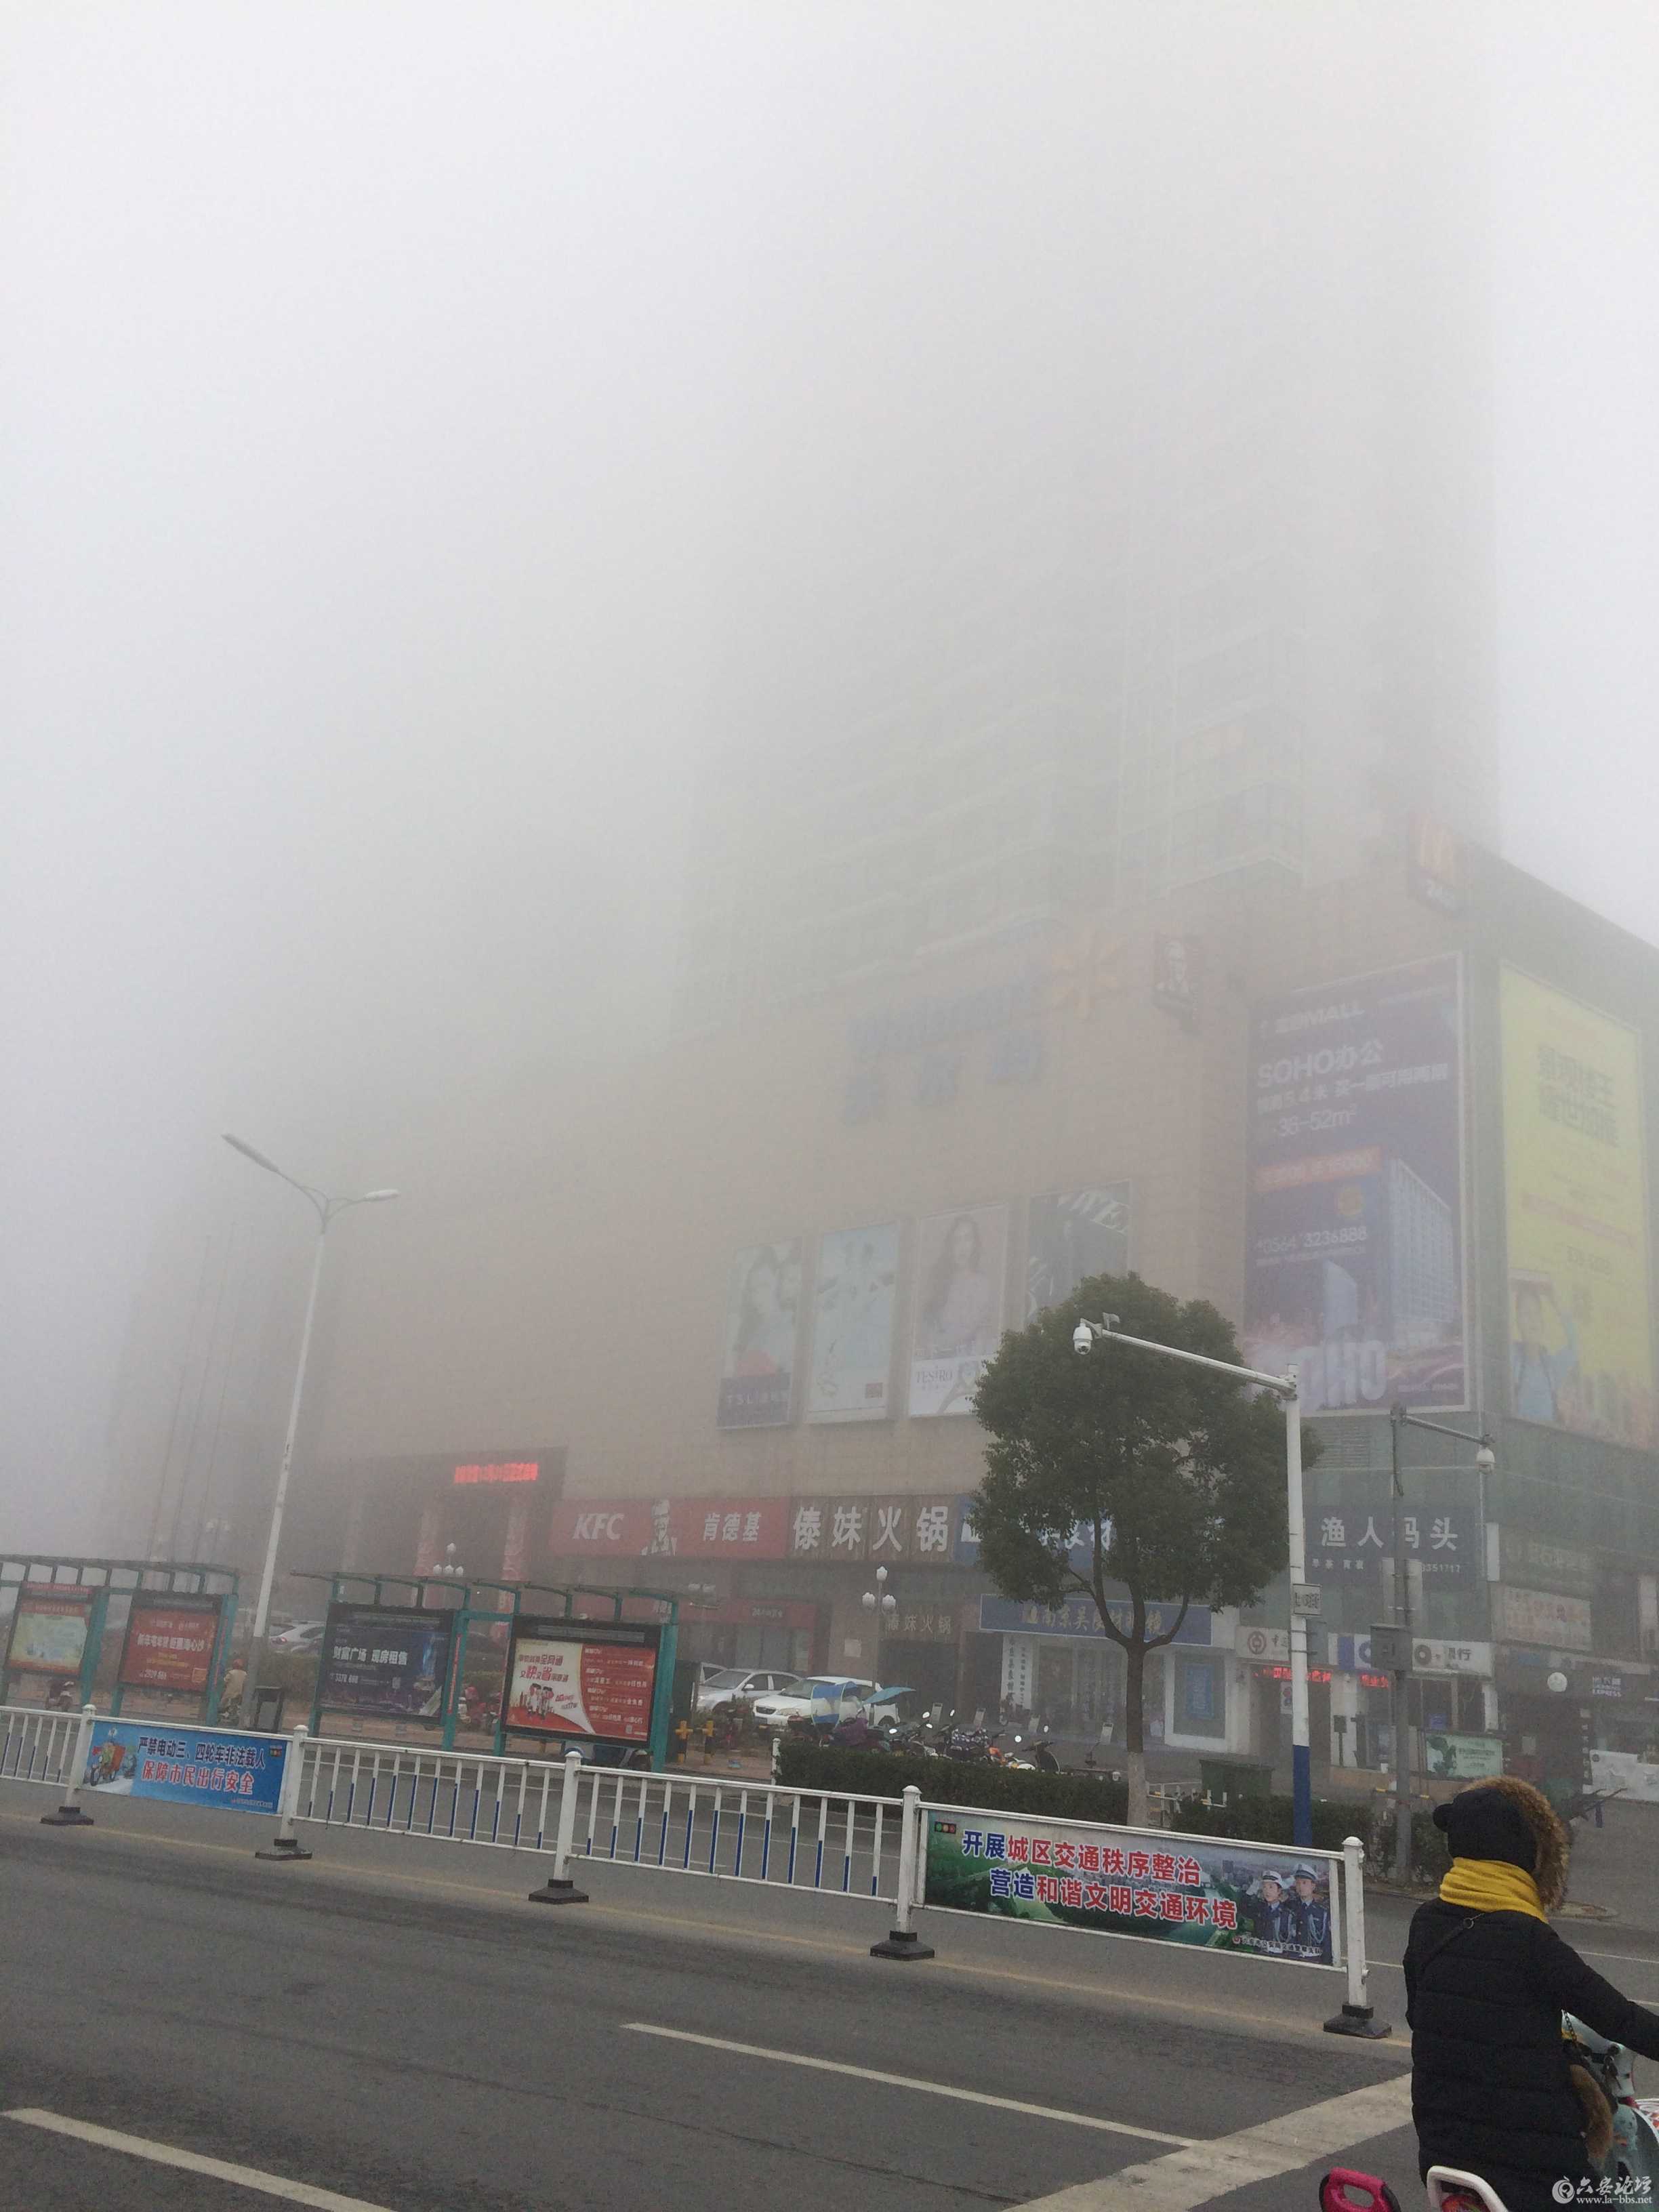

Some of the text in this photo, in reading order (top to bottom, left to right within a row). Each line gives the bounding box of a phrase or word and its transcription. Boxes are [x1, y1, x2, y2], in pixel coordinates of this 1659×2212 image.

[572, 1512, 625, 1540] KFC
[702, 1511, 760, 1543] 肯德基
[793, 1505, 949, 1553] 傣妹火锅
[333, 1646, 367, 1662] 财富广场
[137, 1736, 265, 1769] 严禁电动三、四轮车非法载人
[141, 1761, 255, 1795] 保障市民出行安全
[961, 1829, 1202, 1887] 开展城区交通秩序整治
[989, 1868, 1238, 1930] 营造和谐文明交通环境
